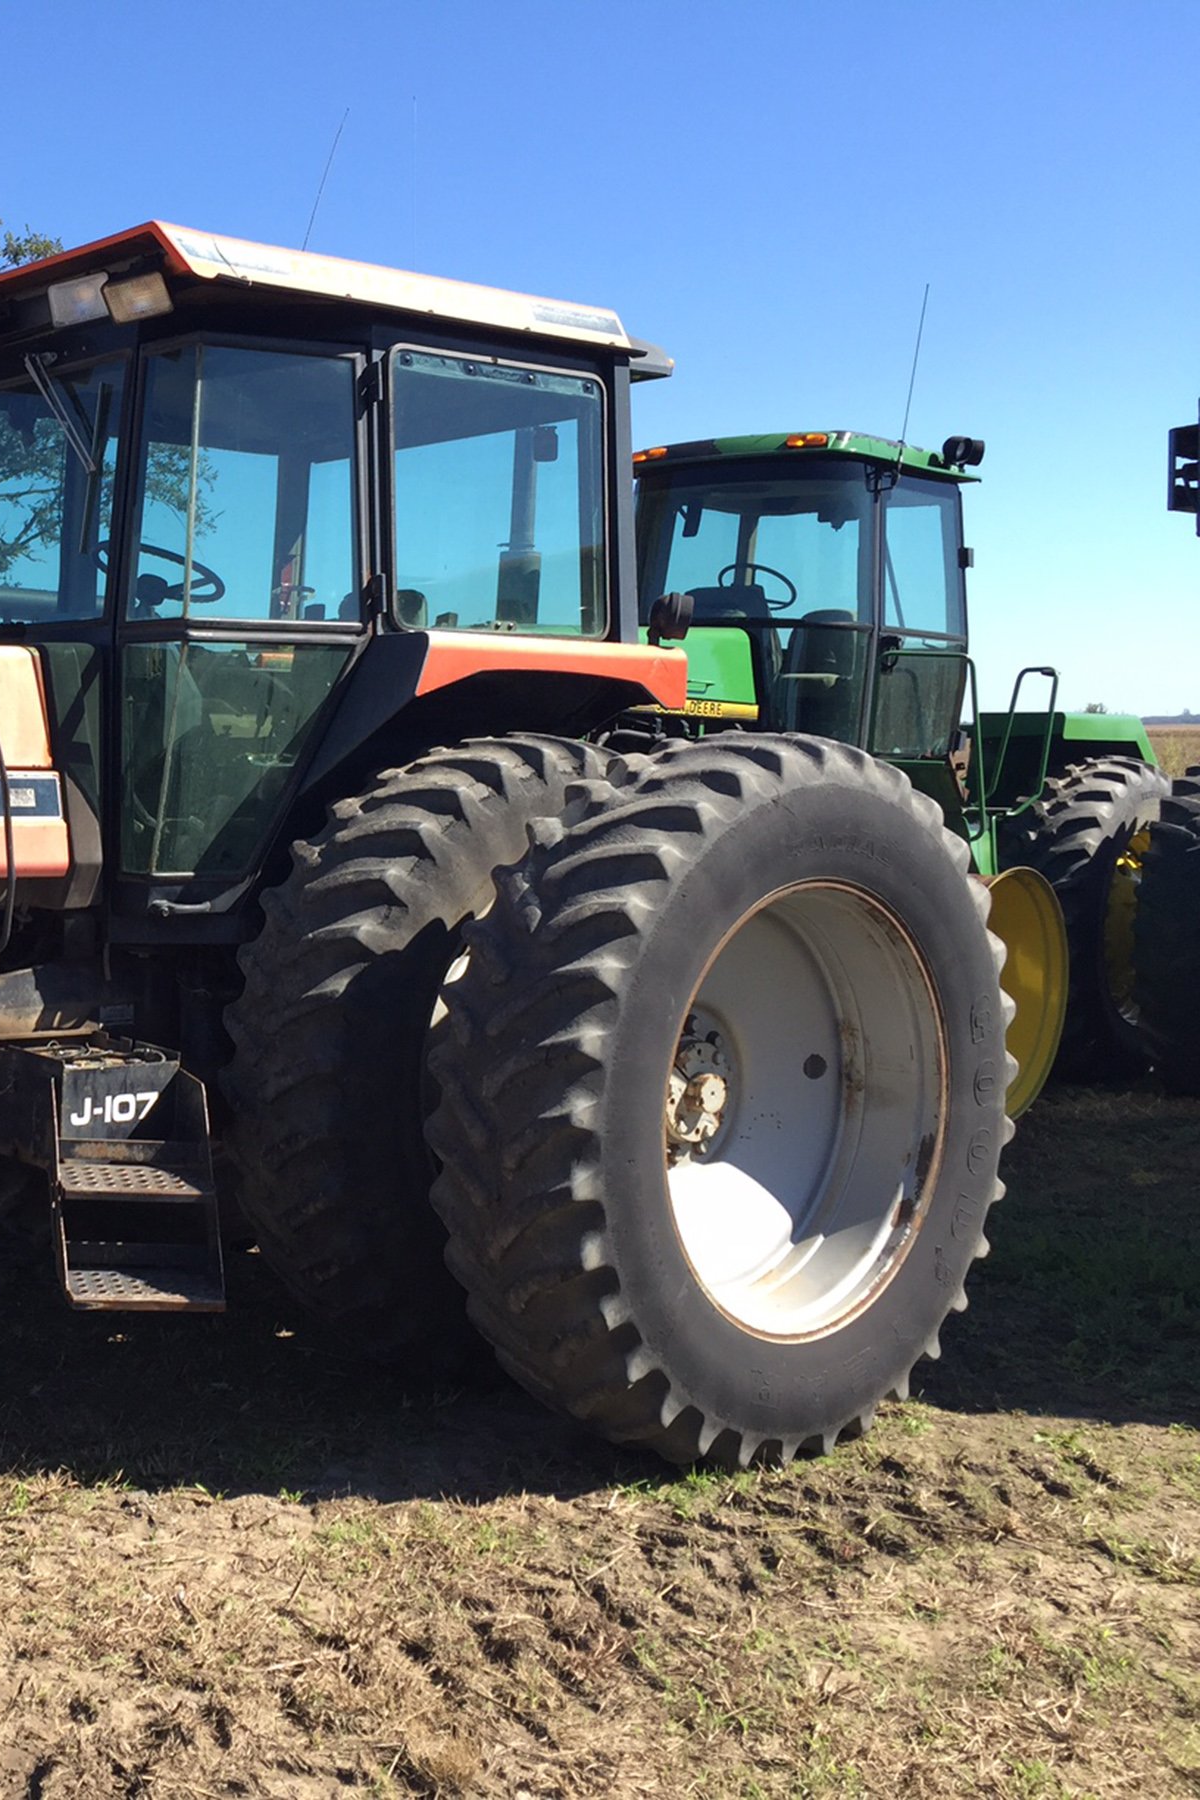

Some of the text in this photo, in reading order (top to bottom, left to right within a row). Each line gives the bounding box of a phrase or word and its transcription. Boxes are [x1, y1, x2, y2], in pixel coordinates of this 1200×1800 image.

[689, 701, 723, 716] DEERE
[788, 830, 896, 868] ADIAL
[70, 1091, 159, 1127] J-107
